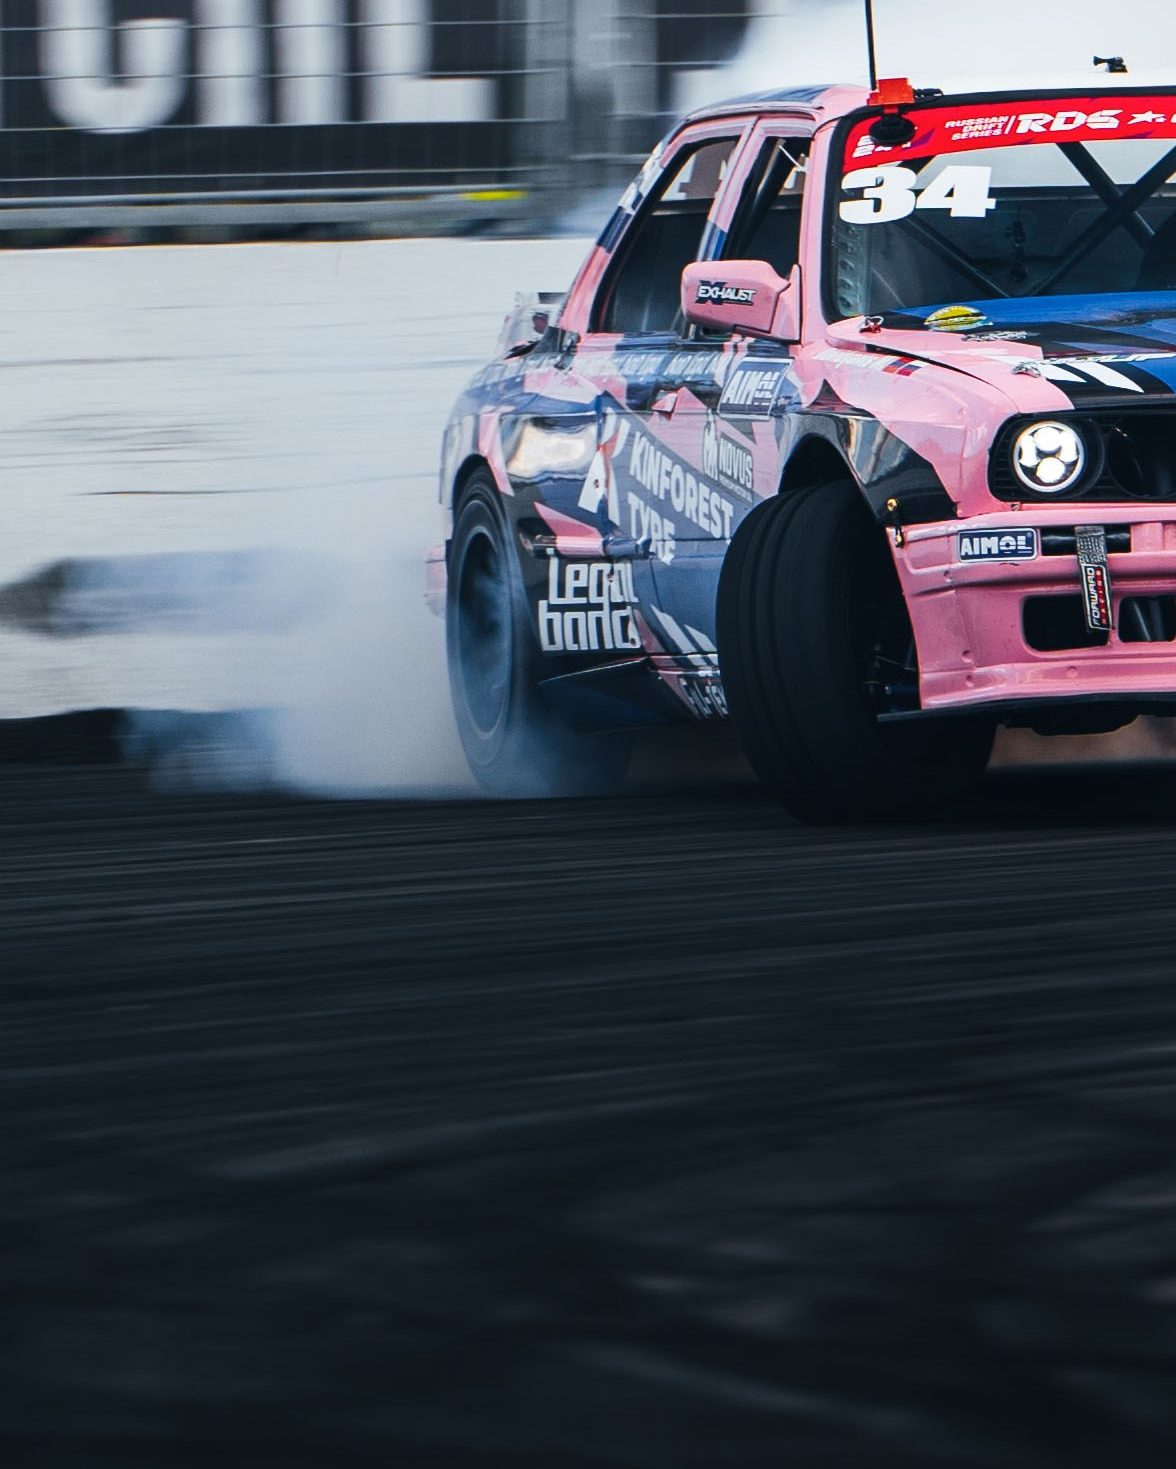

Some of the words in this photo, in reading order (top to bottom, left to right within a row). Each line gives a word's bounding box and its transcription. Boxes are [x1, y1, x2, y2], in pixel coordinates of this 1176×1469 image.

[945, 115, 1009, 129] RUSSIAN
[961, 122, 1006, 133] DRIFT
[1015, 109, 1123, 134] RDS
[951, 128, 1002, 141] SERIES
[839, 165, 997, 224] 34
[696, 282, 757, 304] EXHAUST
[719, 437, 753, 489] NOVUS
[629, 431, 734, 545] KINFOREST
[627, 492, 677, 566] TYRE
[960, 534, 1033, 556] AIMOL
[1085, 567, 1101, 626] FORWARD
